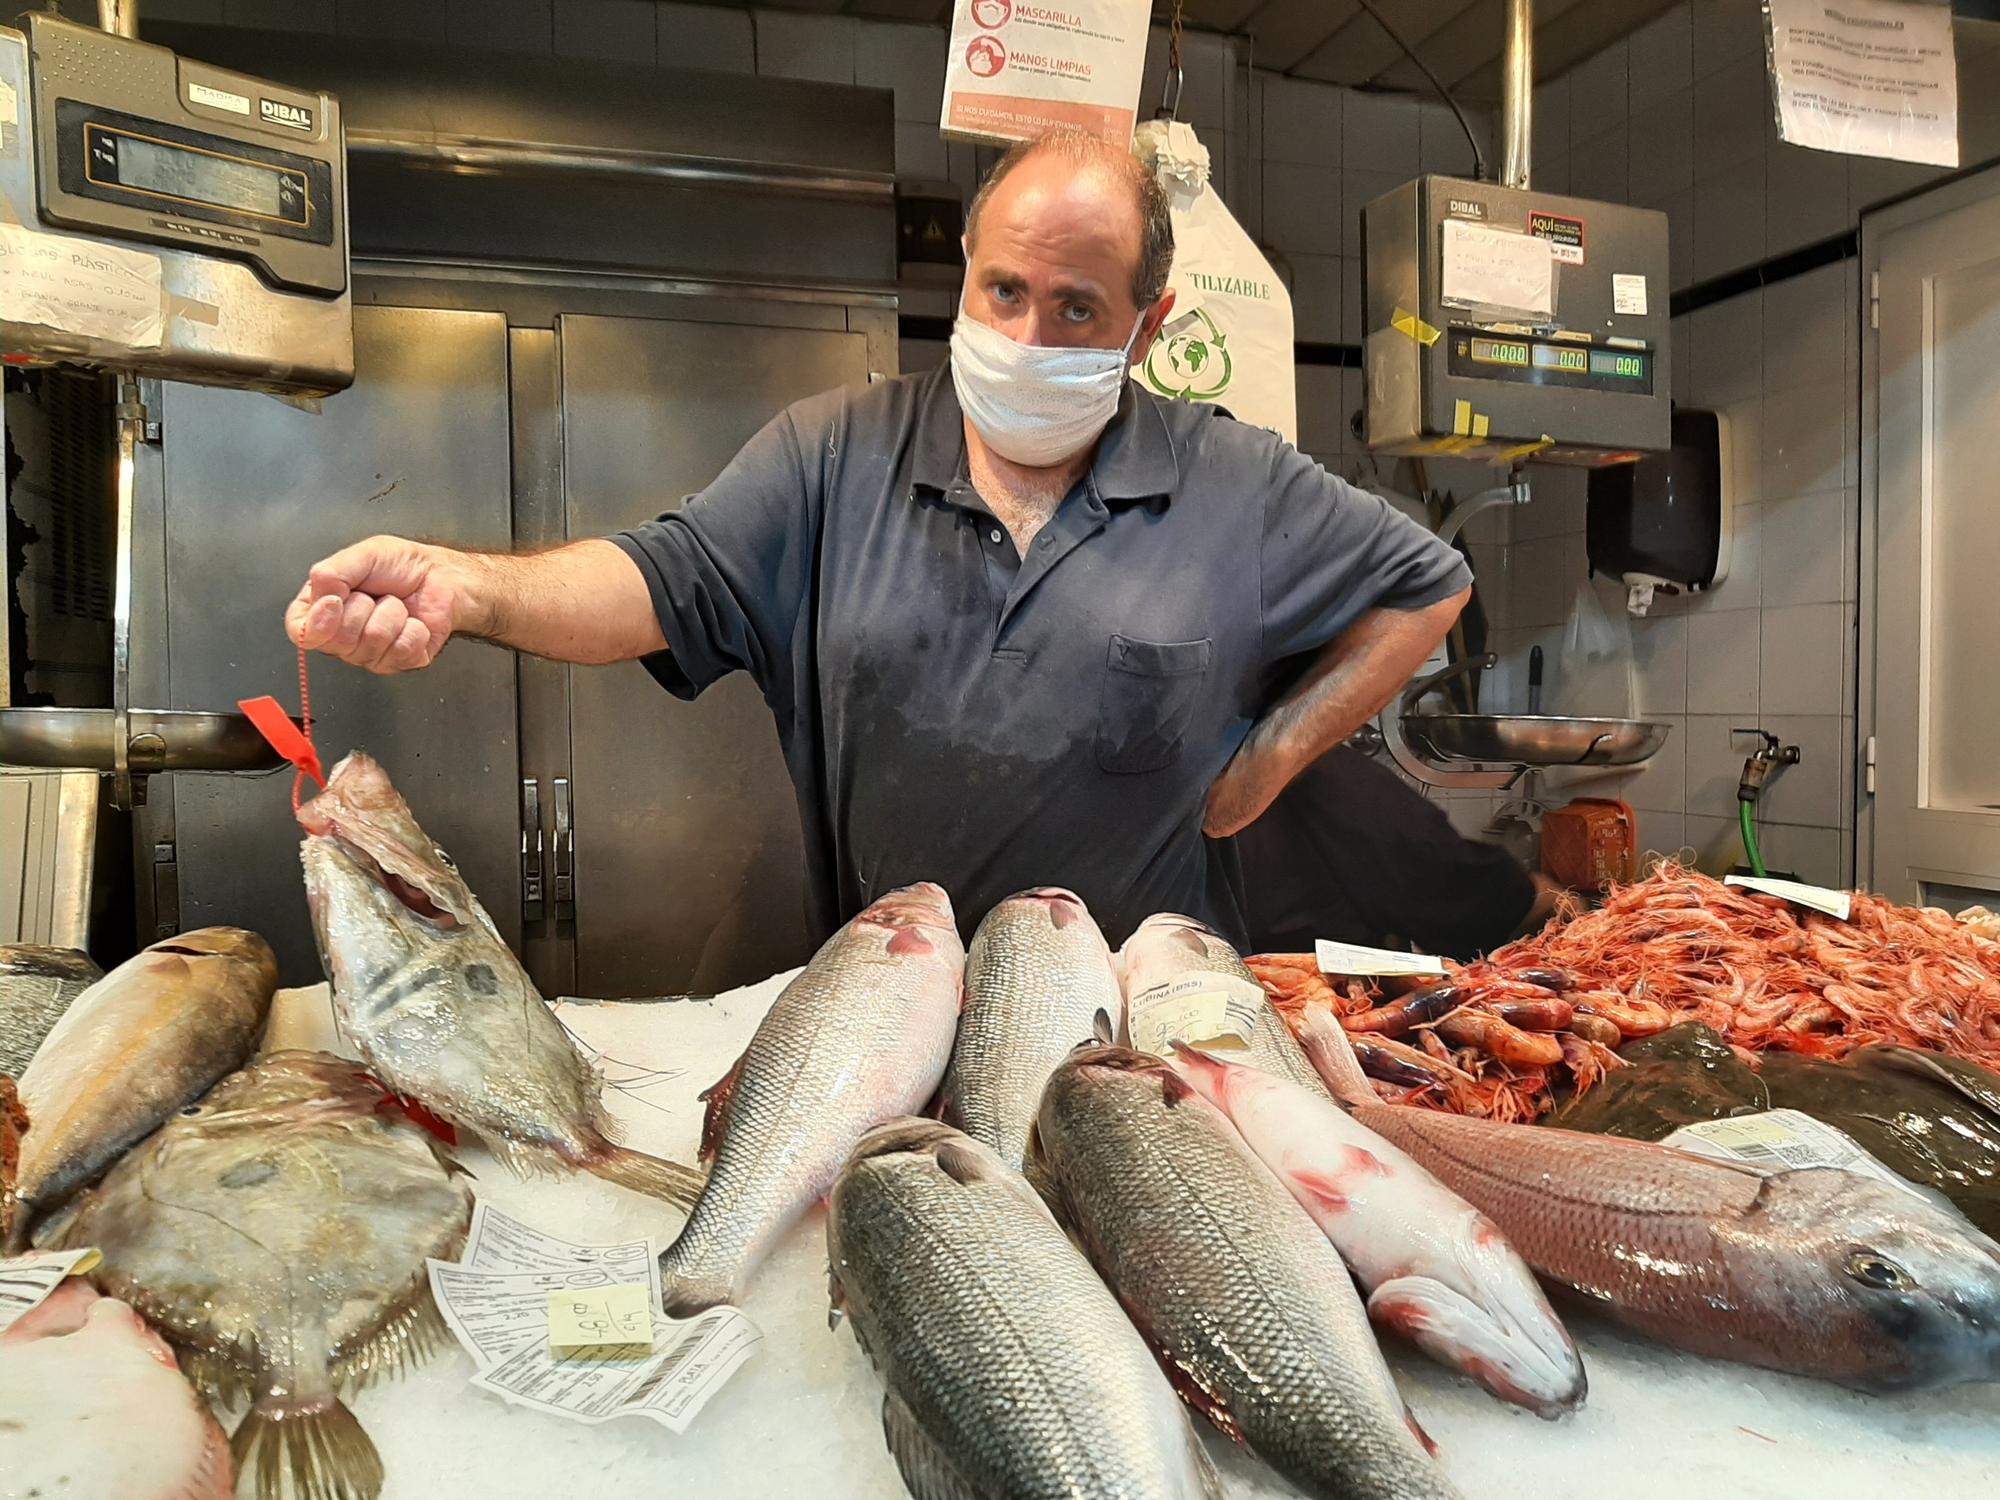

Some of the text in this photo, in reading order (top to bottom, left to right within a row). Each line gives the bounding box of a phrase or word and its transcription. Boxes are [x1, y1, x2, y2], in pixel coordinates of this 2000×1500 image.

[1015, 5, 1082, 27] MASCARILLA
[1010, 51, 1091, 75] MANOS LIMPIAS
[260, 99, 312, 126] DIBAL
[1450, 200, 1482, 216] DIBAL
[1186, 272, 1271, 300] TILIZABLE
